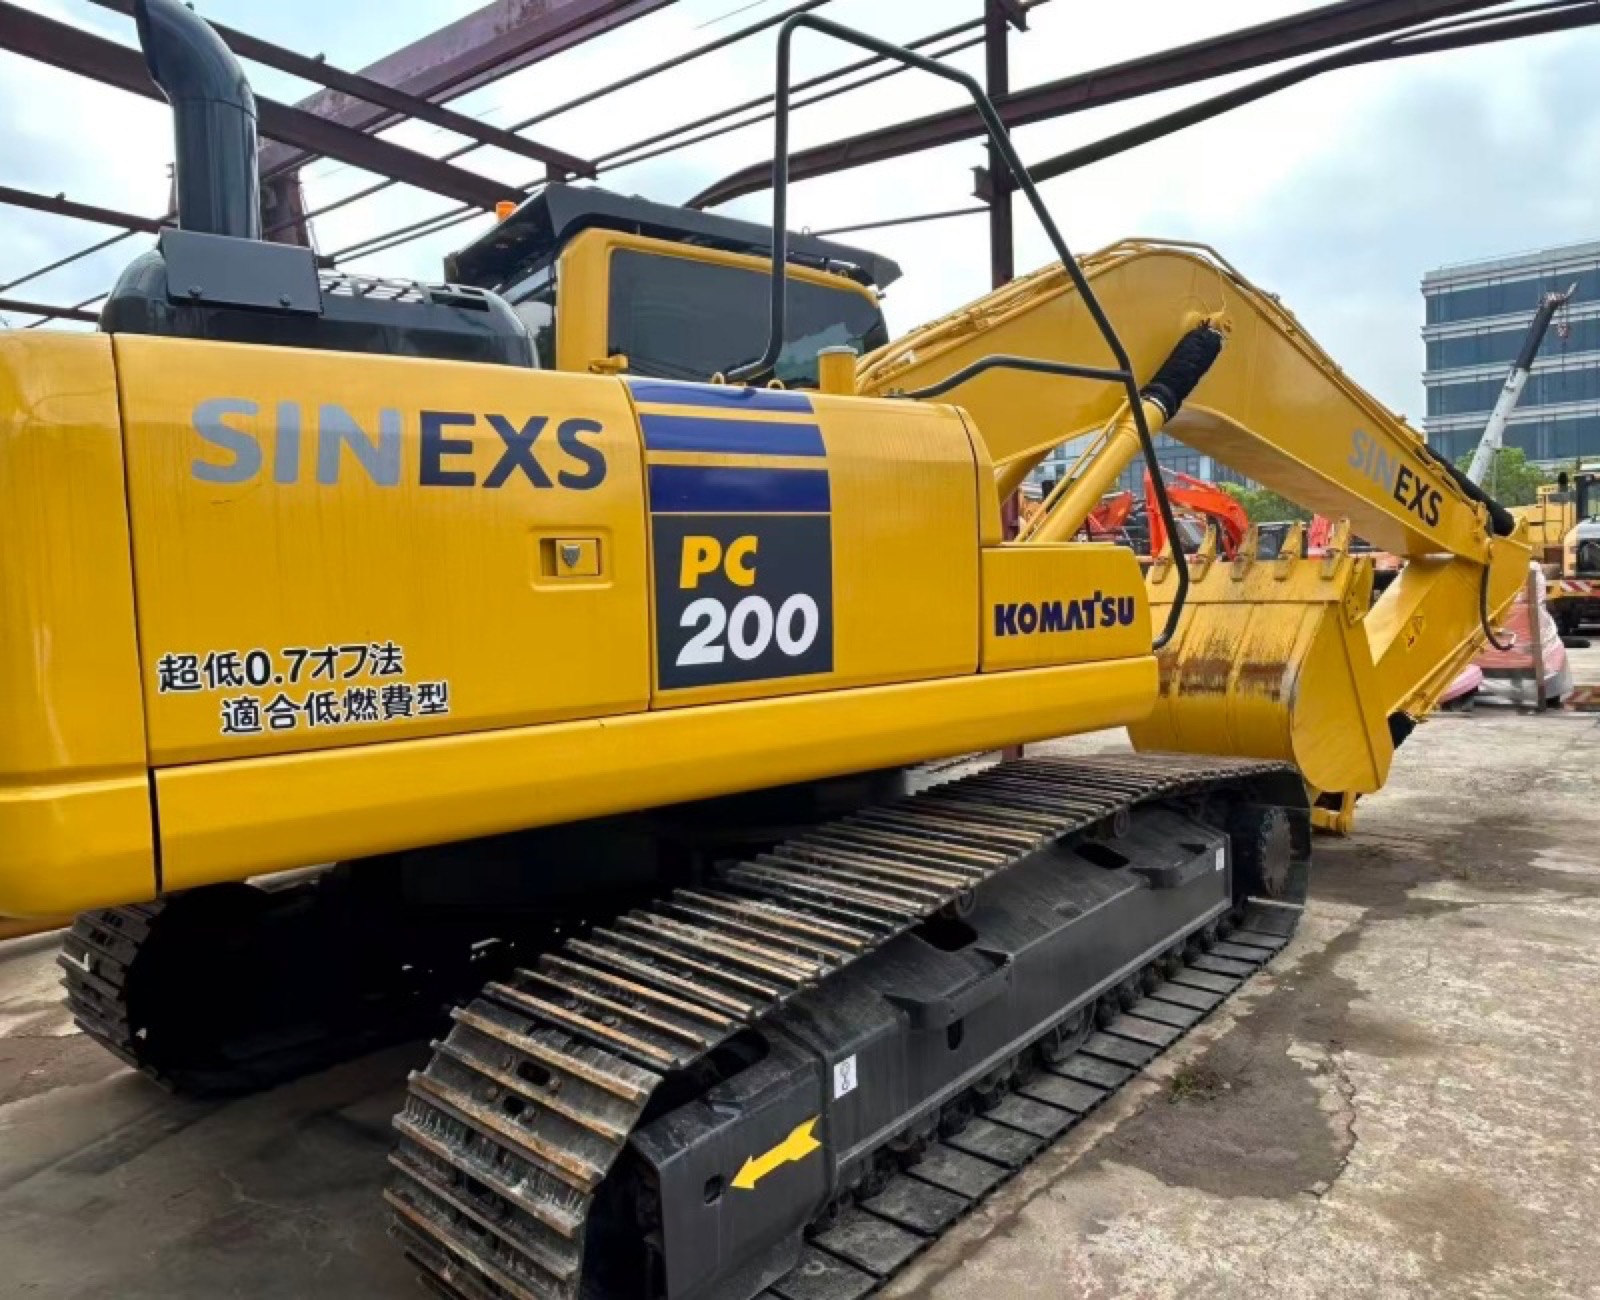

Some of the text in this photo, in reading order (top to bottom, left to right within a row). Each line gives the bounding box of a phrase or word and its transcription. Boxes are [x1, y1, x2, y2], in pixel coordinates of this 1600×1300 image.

[191, 397, 607, 490] SINEXS
[1347, 428, 1442, 528] SINEXS
[680, 535, 758, 588] PC
[676, 593, 819, 666] 200
[995, 590, 1134, 636] KOMATSU
[158, 641, 404, 693] 超低0.7オフ法
[221, 681, 449, 733] 適合低燃費型
